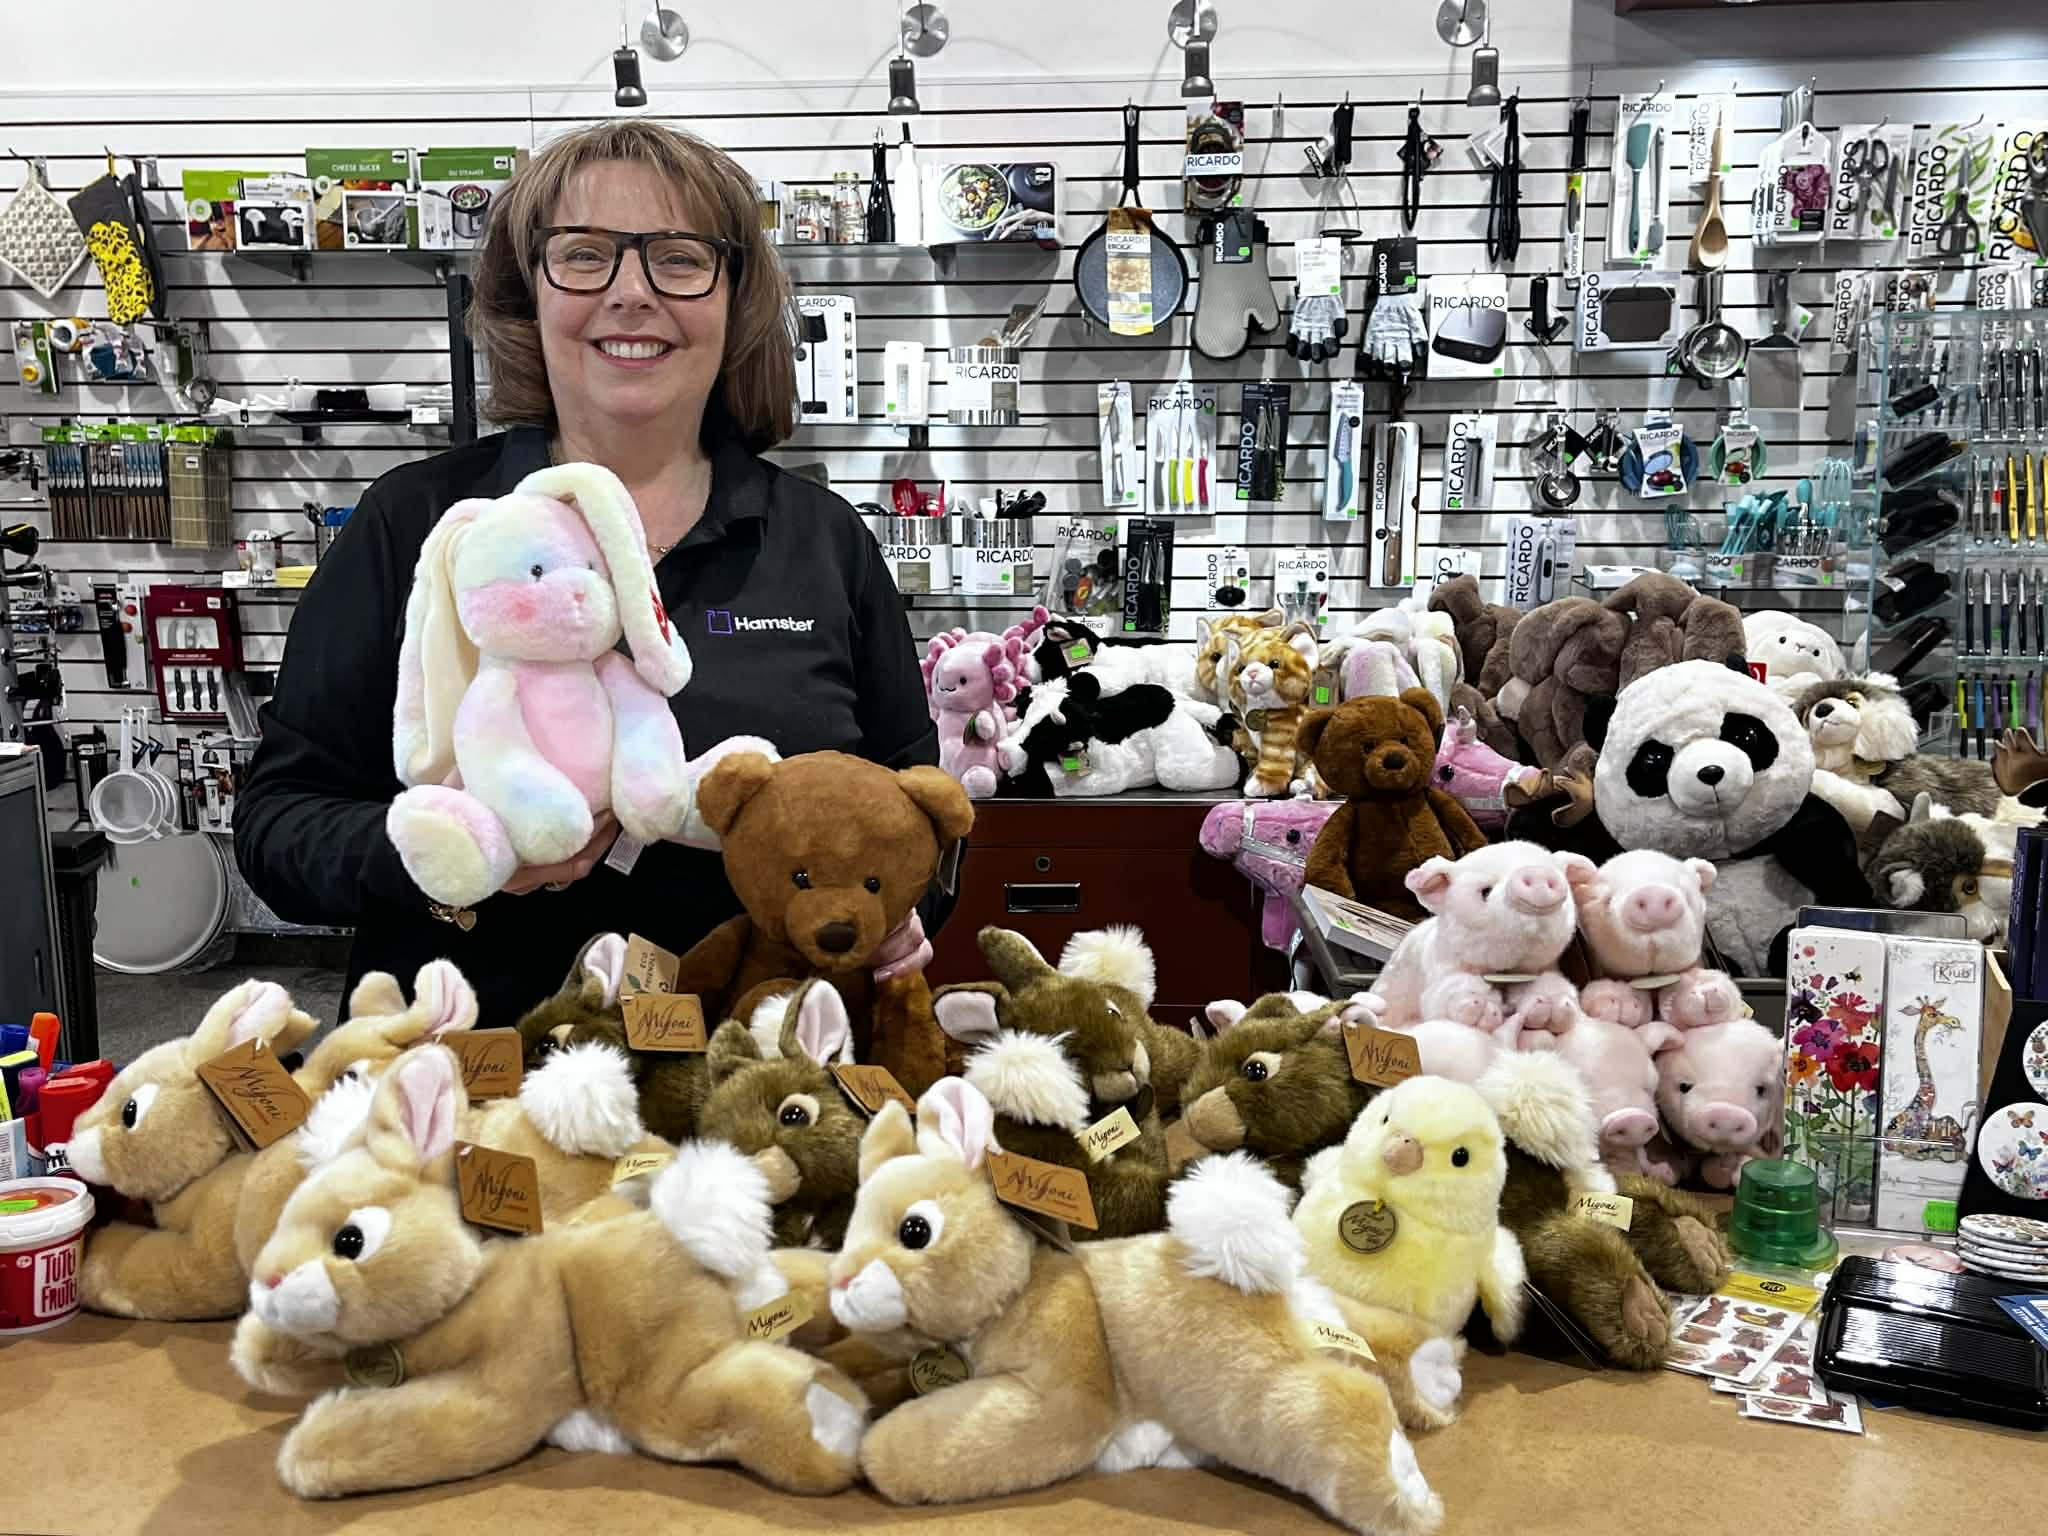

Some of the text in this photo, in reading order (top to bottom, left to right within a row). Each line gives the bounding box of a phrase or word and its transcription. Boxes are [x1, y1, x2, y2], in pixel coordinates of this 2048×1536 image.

[1622, 103, 1672, 113] RICARDO
[1695, 102, 1710, 170] RICARDO
[331, 164, 357, 172] CHEESE
[1187, 154, 1241, 167] RICARDO
[1775, 165, 1789, 226] RICARDO
[1834, 141, 1857, 230] RICARDO
[1925, 145, 1949, 241] RICARDO
[1108, 235, 1149, 243] RICARDO
[1215, 222, 1225, 262] RICARDO
[1379, 253, 1388, 294] RICARDO
[1433, 296, 1505, 309] RICARDO
[1585, 274, 1600, 347] RICARDO
[1836, 278, 1852, 344] RICARDO
[955, 366, 1018, 379] RICARDO
[1149, 398, 1215, 410] RICARDO
[1640, 429, 1680, 440] RICARDO
[1238, 422, 1255, 497] ICARDO
[1448, 422, 1468, 508] RICARDO
[1376, 462, 1386, 510] RICARDO
[1058, 526, 1113, 542] RICARDO
[1208, 553, 1218, 608] RICARDO
[1278, 560, 1327, 570] RICARDO
[1516, 526, 1533, 602] RICARDO
[734, 616, 815, 631] Hamster
[640, 952, 648, 969] ECO
